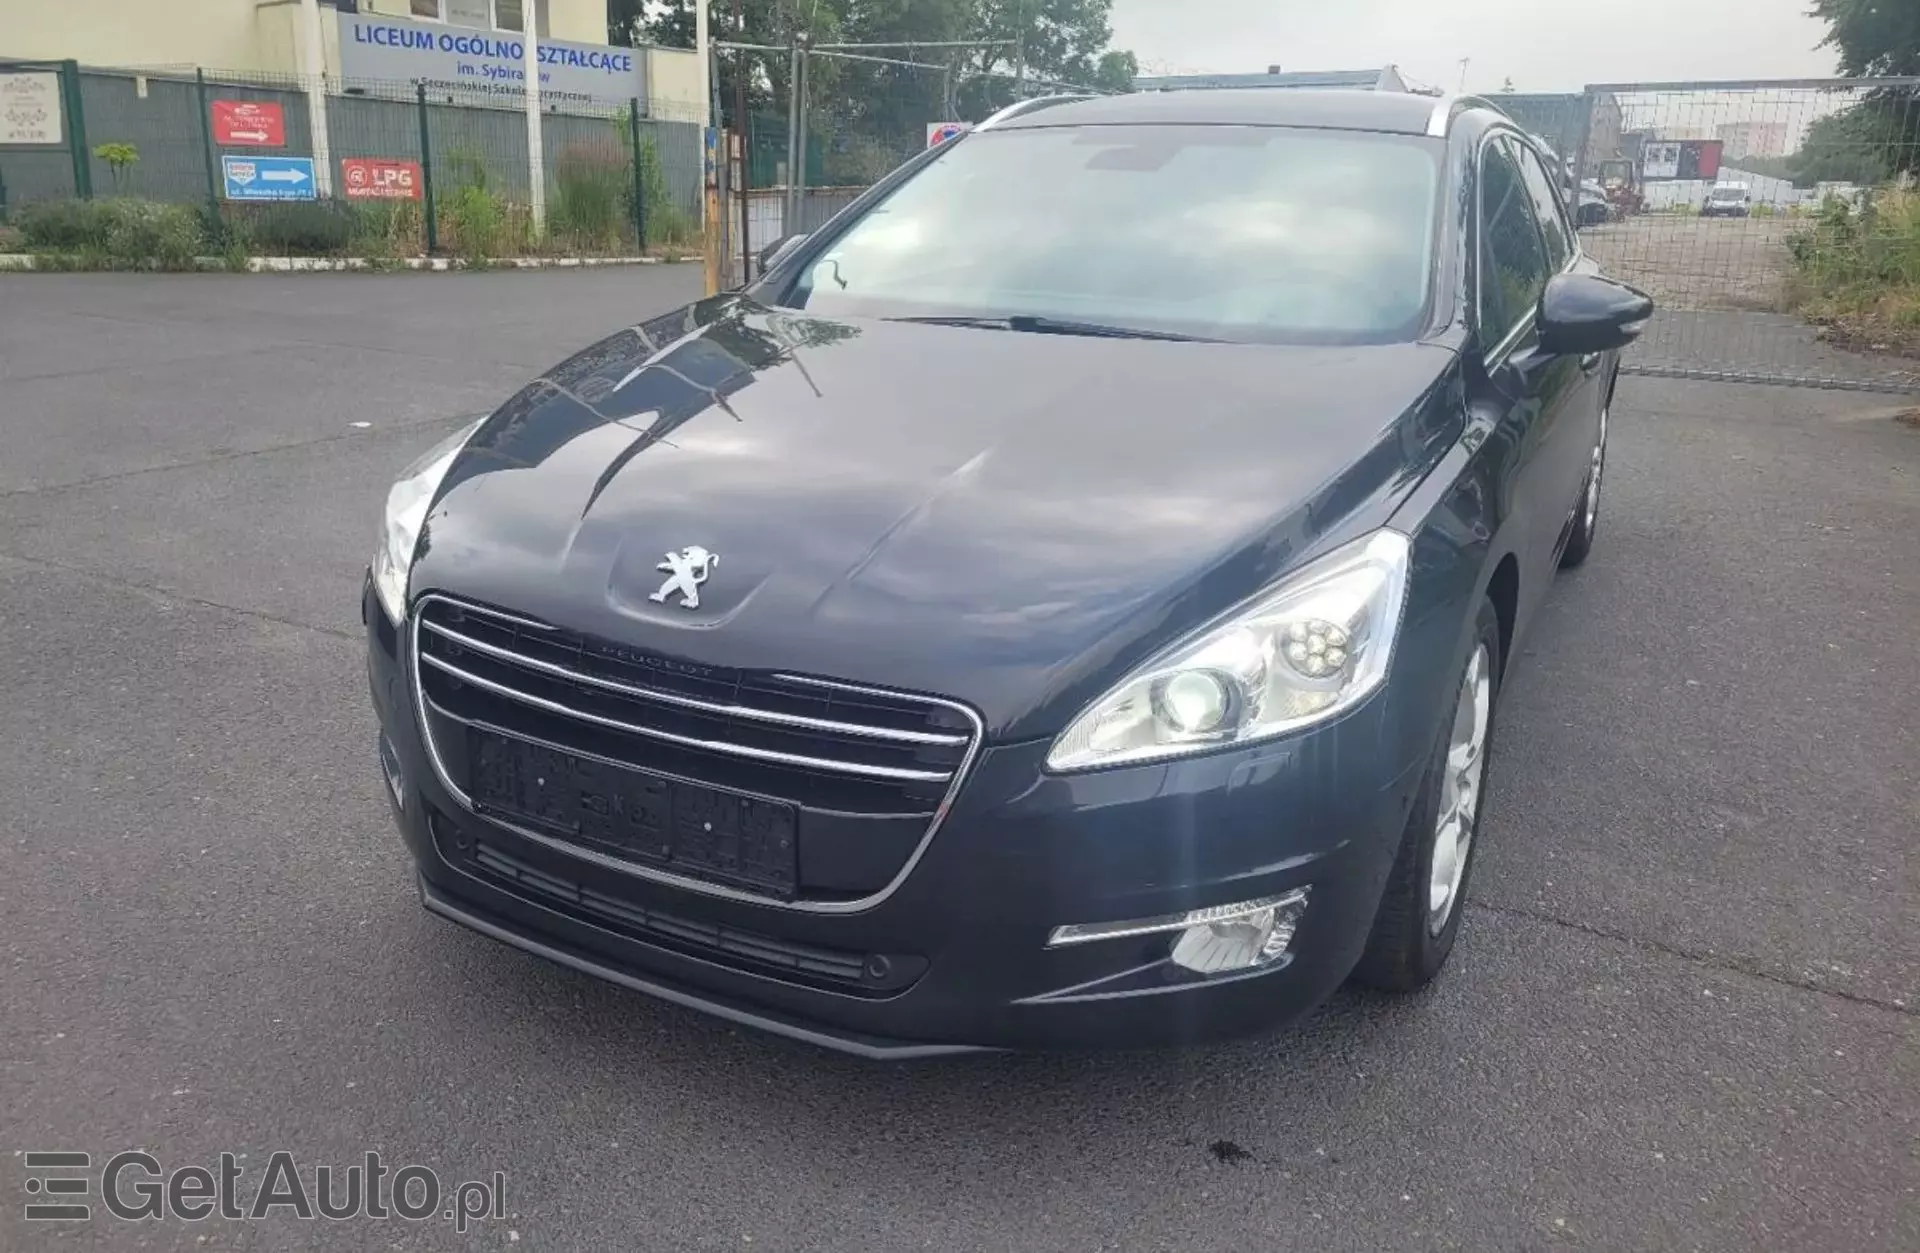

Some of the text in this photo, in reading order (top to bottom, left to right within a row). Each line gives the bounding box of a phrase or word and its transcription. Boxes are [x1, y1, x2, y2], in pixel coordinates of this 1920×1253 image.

[354, 24, 632, 74] LICEUM OGÓLNOSZTAŁCĄCE
[457, 60, 550, 83] im. Sybiraw
[372, 168, 413, 186] LPG
